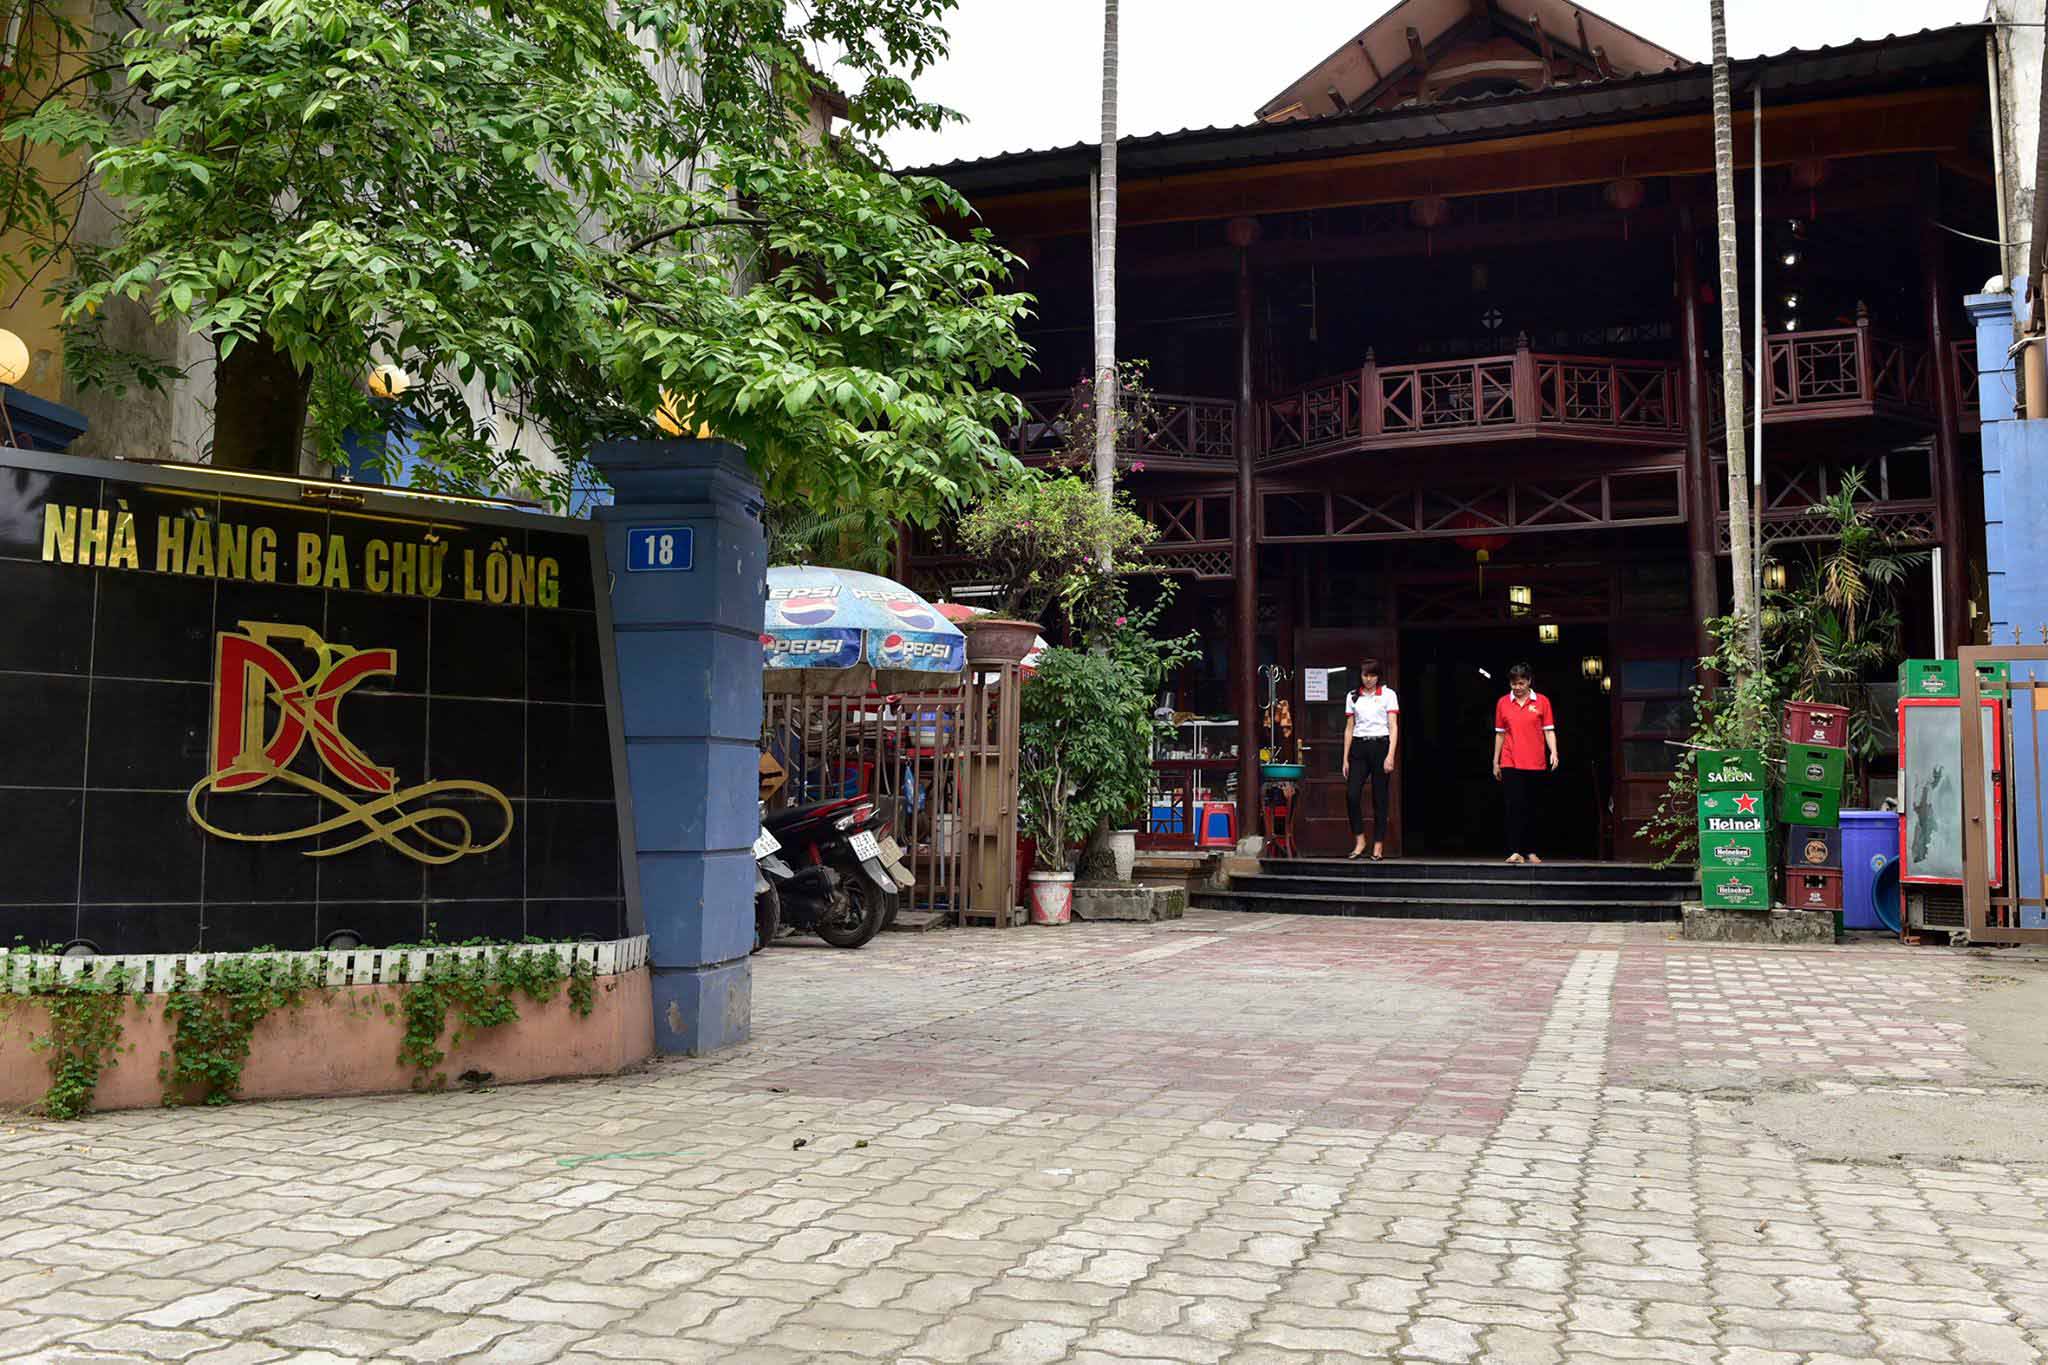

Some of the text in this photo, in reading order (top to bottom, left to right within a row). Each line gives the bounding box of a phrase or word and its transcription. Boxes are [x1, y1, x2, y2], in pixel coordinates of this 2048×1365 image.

[42, 499, 560, 609] NHÀ HÀNG BA CHỮ LỒNG
[644, 534, 674, 565] 18
[774, 638, 844, 656] PEPSI
[902, 642, 951, 660] PEPSI
